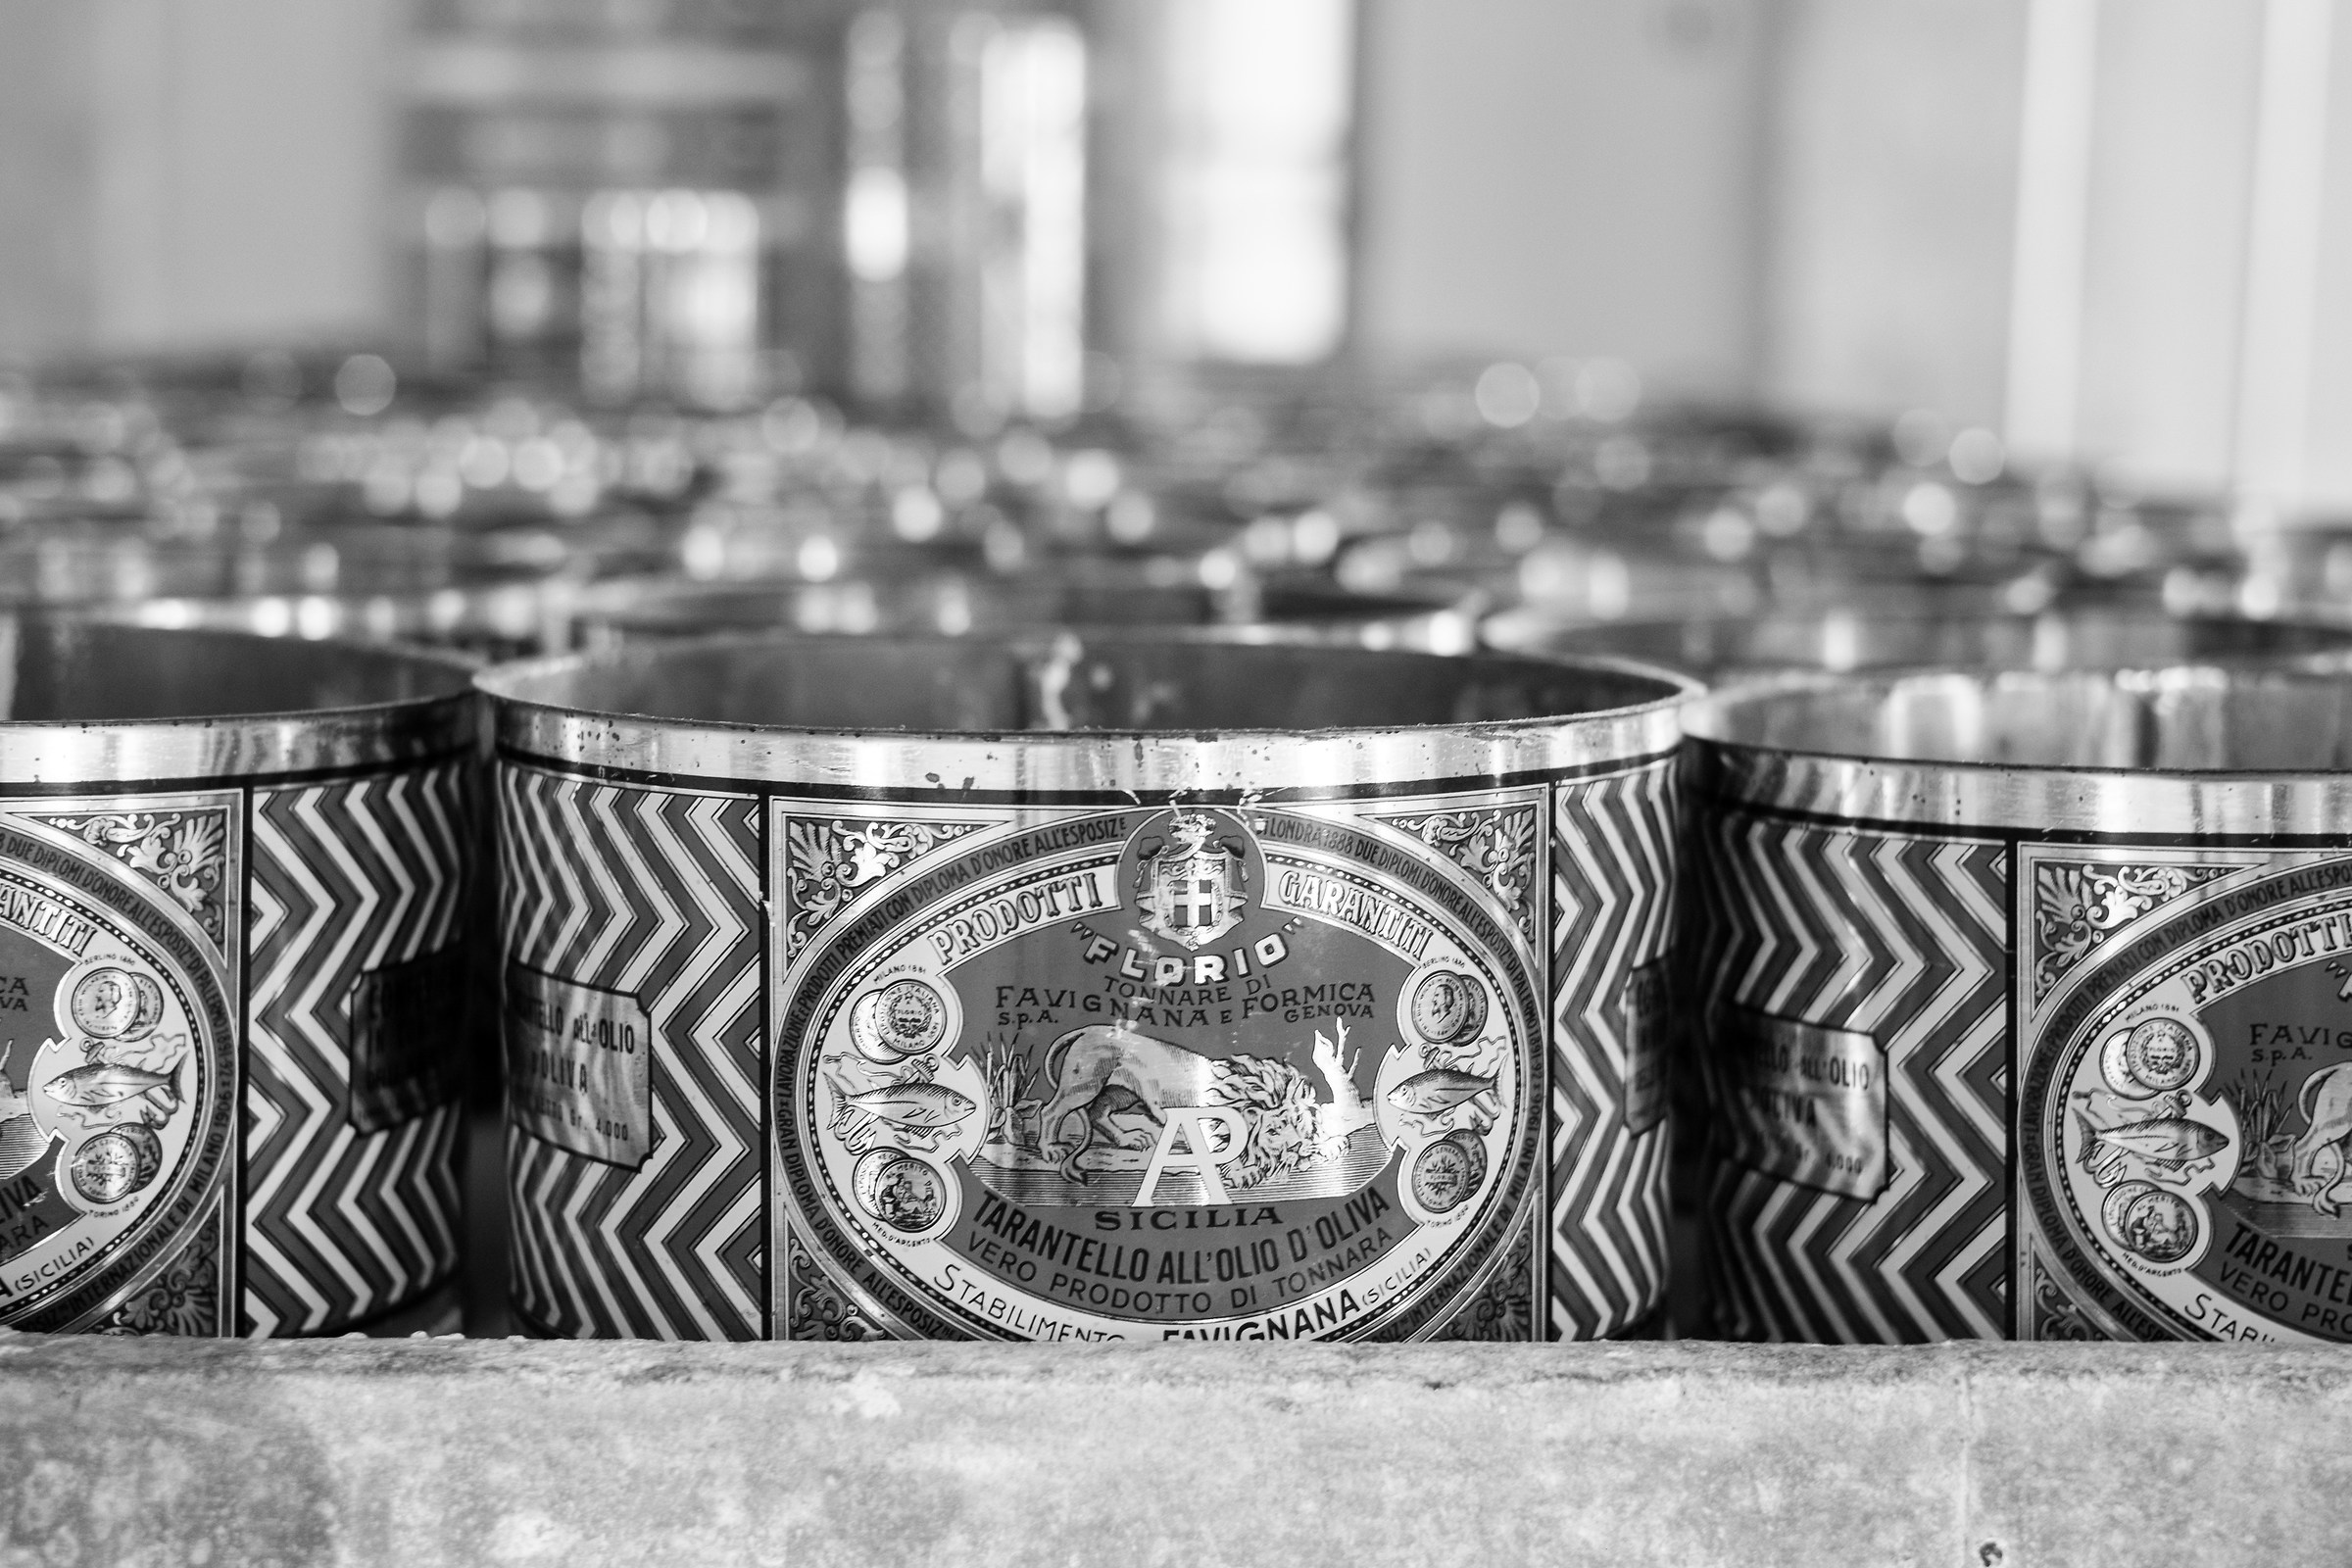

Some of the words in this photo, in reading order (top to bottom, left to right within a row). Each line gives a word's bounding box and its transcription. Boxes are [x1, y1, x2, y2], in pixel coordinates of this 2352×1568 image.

[1271, 817, 1321, 843] LONDRA
[1354, 839, 1379, 863] DUE
[7, 836, 35, 860] DUE
[32, 845, 85, 883] DIPLOMI
[81, 871, 134, 910] D'ONORE
[1377, 848, 1423, 886] DIPLOMI
[1420, 870, 1465, 912] D'ONORE
[927, 872, 1102, 966] PRODOTTI
[1278, 870, 1434, 961] GARANTITI
[2163, 906, 2225, 947] DIPLOMA
[2225, 880, 2287, 916] D'ONORE
[2289, 864, 2352, 896] ALL'ESPO
[777, 1010, 803, 1098] LAVORAZIONE
[797, 953, 842, 1010] PRODOTTI
[835, 912, 889, 959] PREMIATI
[886, 894, 914, 920] CON
[910, 863, 971, 905] DIPLOMA
[970, 838, 1032, 875] D'ONORE
[1506, 957, 1521, 976] DI
[2180, 912, 2352, 1004] PRODOTTI
[996, 986, 1209, 1027] FAVIGNANA
[1220, 1009, 1232, 1025] E
[1243, 982, 1375, 1020] FORMICA
[1104, 975, 1232, 1006] TONNARE
[1246, 974, 1272, 996] DI
[1284, 1004, 1374, 1023] GENOVA
[1511, 970, 1537, 1028] PALERMO
[778, 1107, 797, 1150] GRAN
[176, 1197, 193, 1215] DI
[188, 1133, 224, 1195] MILANO
[785, 1154, 820, 1220] DIPLOMA
[973, 1190, 1150, 1282] TARANTELLO
[1156, 1239, 1280, 1285] ALL'OLIO
[1287, 1186, 1390, 1262] D'OLIVA
[1095, 1206, 1283, 1231] SICILIA
[1407, 1218, 1502, 1327] INTERNAZIONALE
[1497, 1203, 1512, 1222] DI
[1508, 1137, 1537, 1200] MILANO
[1528, 1094, 1543, 1132] 1906
[2031, 1187, 2068, 1250] DIPLOMA
[15, 1237, 94, 1292] (SICILIA)
[812, 1219, 864, 1274] D'ONORE
[968, 1231, 1037, 1282] VERO
[1050, 1272, 1211, 1314] PRODOTTO
[1231, 1285, 1257, 1309] DI
[1272, 1227, 1393, 1298] TONNARA
[1362, 1248, 1431, 1306] (SICILIA)
[2221, 1260, 2288, 1311] VERO
